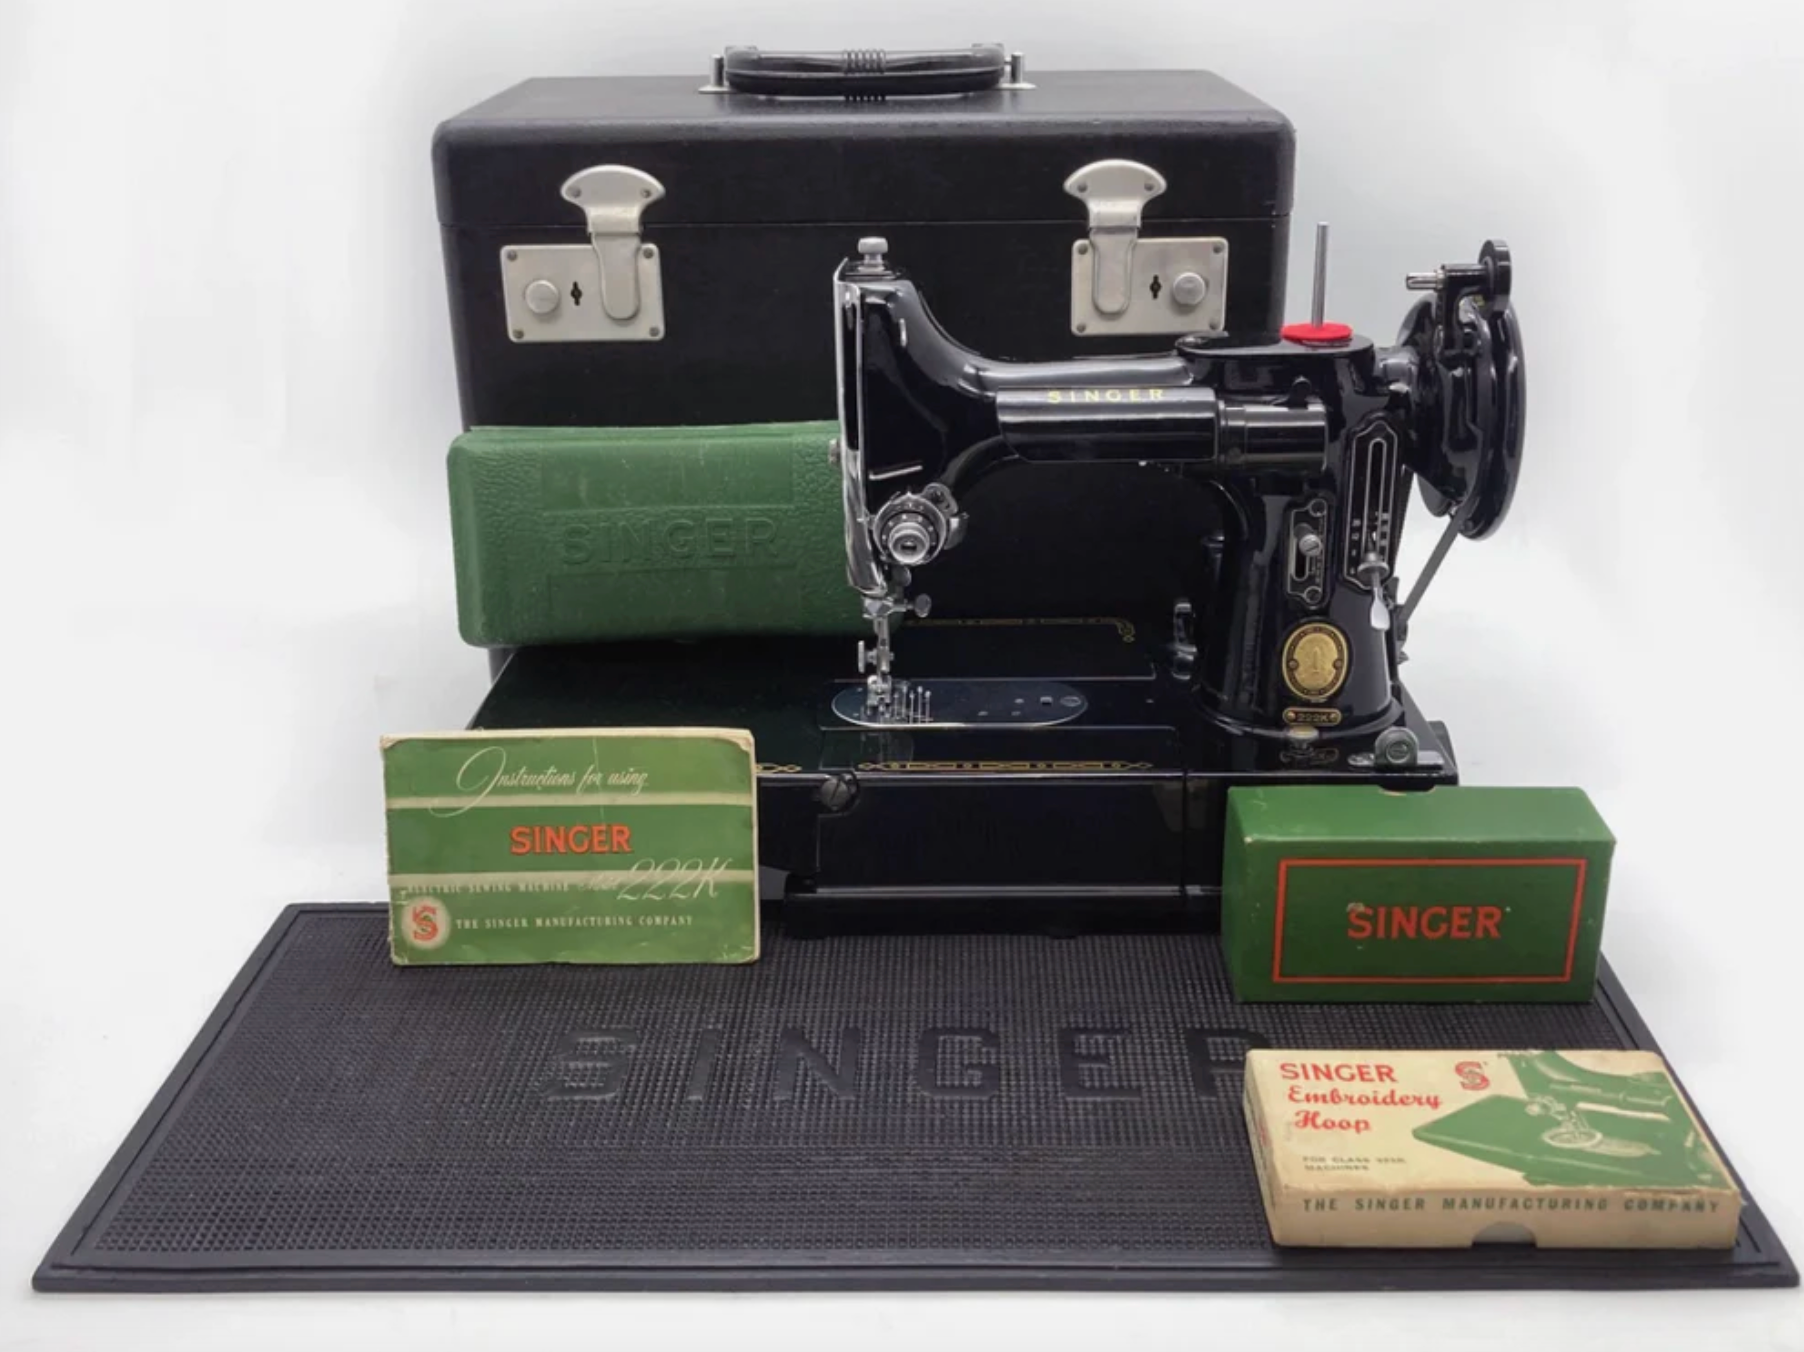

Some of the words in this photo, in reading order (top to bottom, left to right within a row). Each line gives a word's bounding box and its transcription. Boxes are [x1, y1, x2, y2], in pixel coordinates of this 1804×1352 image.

[1047, 388, 1164, 404] SINGER
[562, 516, 780, 565] SINGER
[428, 746, 576, 818] Instructions
[576, 764, 604, 795] for
[606, 767, 650, 797] using
[509, 823, 634, 856] SINGER
[616, 856, 734, 901] 222K
[455, 918, 479, 930] THE
[484, 917, 529, 929] SINGER
[535, 915, 633, 928] MANUFACTURING
[639, 914, 694, 927] COMPANY
[1346, 904, 1503, 940] SINGER
[538, 1026, 1272, 1101] SINGER
[1279, 1062, 1399, 1083] SINGER
[1287, 1084, 1443, 1110] Embroidery
[1294, 1109, 1373, 1133] Hoop
[1303, 1197, 1338, 1212] THE
[1354, 1197, 1426, 1212] SINGER
[1442, 1196, 1608, 1211] MANUFACTURING
[1623, 1197, 1720, 1213] COMPANY
